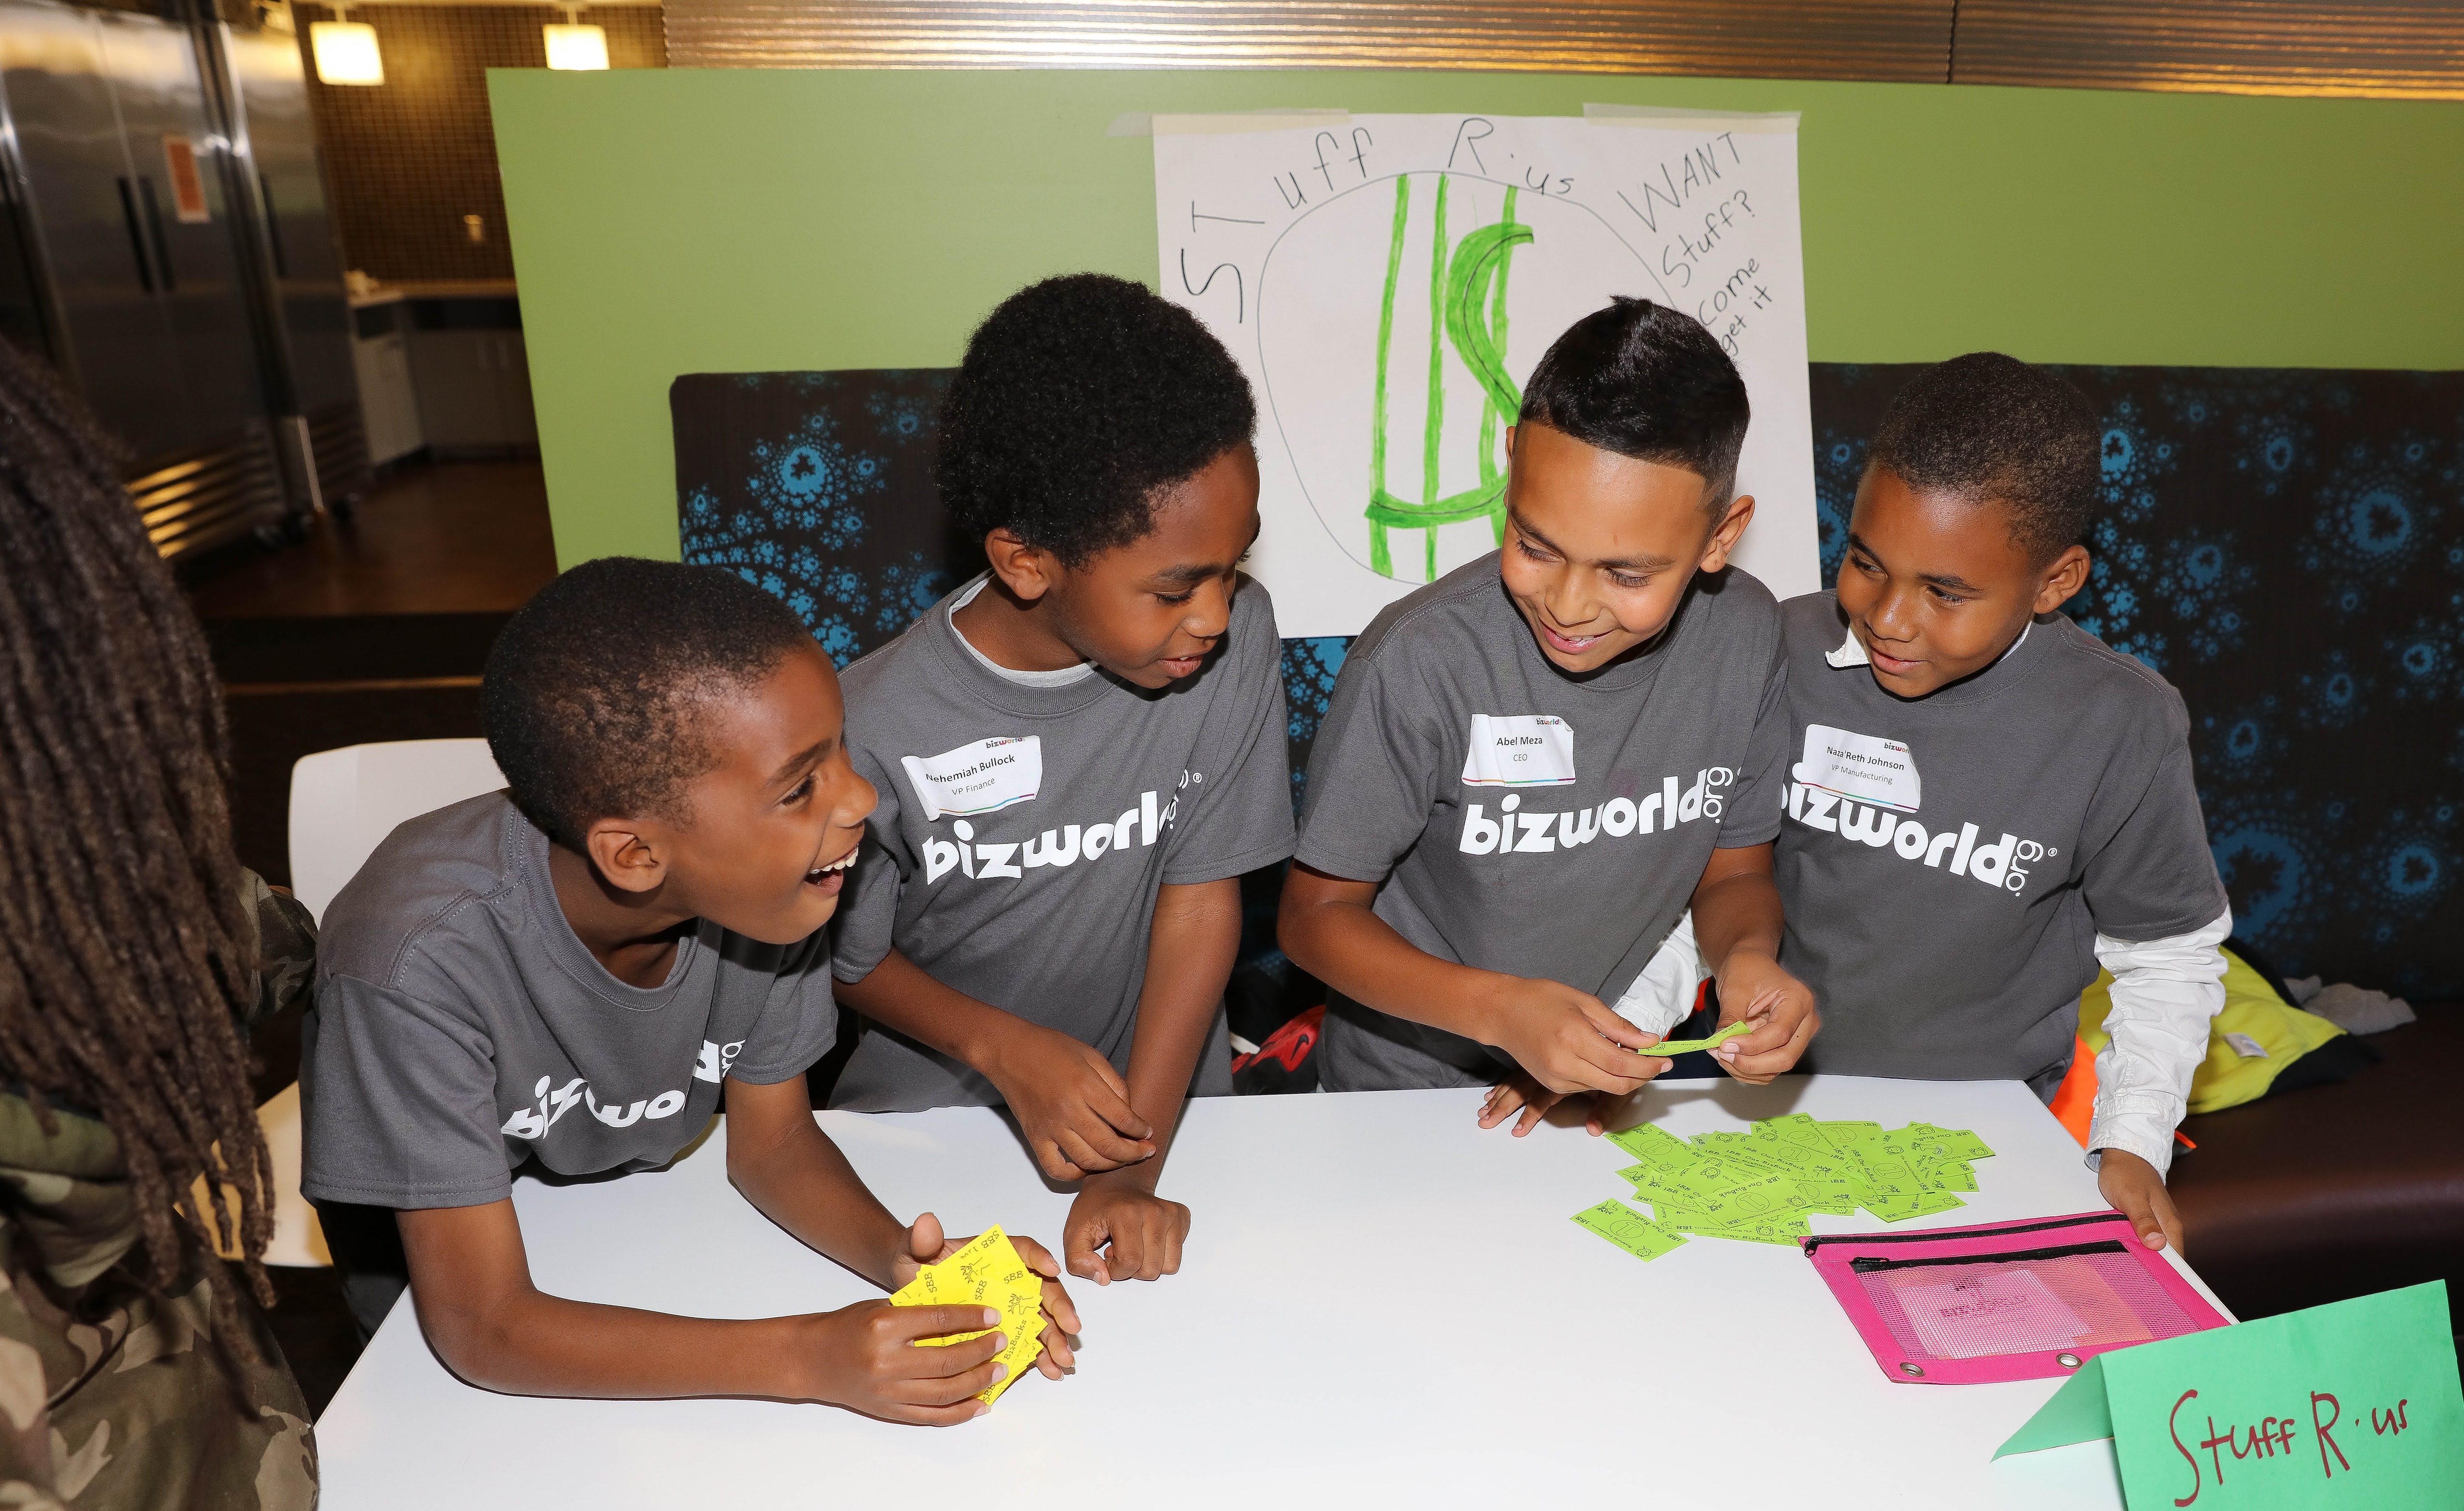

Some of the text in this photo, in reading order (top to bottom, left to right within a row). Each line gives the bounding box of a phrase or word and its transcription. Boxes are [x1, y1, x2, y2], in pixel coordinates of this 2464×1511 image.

[1617, 131, 1739, 233] WANT
[1663, 190, 1755, 288] Stuff?
[1721, 285, 1773, 357] get it
[1497, 737, 1543, 746] Abel Meza
[926, 754, 1015, 783] Nehemiah Bullock
[1827, 746, 1904, 771] Naza'Reth Johnson
[1841, 766, 1893, 785] Manufacturing
[951, 778, 995, 796] VP Finance
[1459, 768, 1708, 855] bizworld
[1658, 1131, 1679, 1144] BizBuck
[1762, 1161, 1791, 1172] BizBuck
[1777, 1158, 1805, 1170] BizBuck
[1851, 1149, 1861, 1157] 1BB
[1864, 1167, 1879, 1182] BizBuck
[1766, 1175, 1780, 1183] 1BB
[1966, 1182, 1974, 1190] 1BB
[1719, 1186, 1747, 1198] BizBuck
[1575, 1216, 1590, 1225] 1BB
[1625, 1210, 1682, 1241] BizBuck One 1BB
[981, 1230, 999, 1249] 5BB
[924, 1272, 937, 1293] 5BB
[1004, 1270, 1023, 1284] 5BB
[975, 1280, 987, 1301] 5BB
[1004, 1319, 1027, 1360] BizBucks
[2169, 1389, 2296, 1507] Stuff
